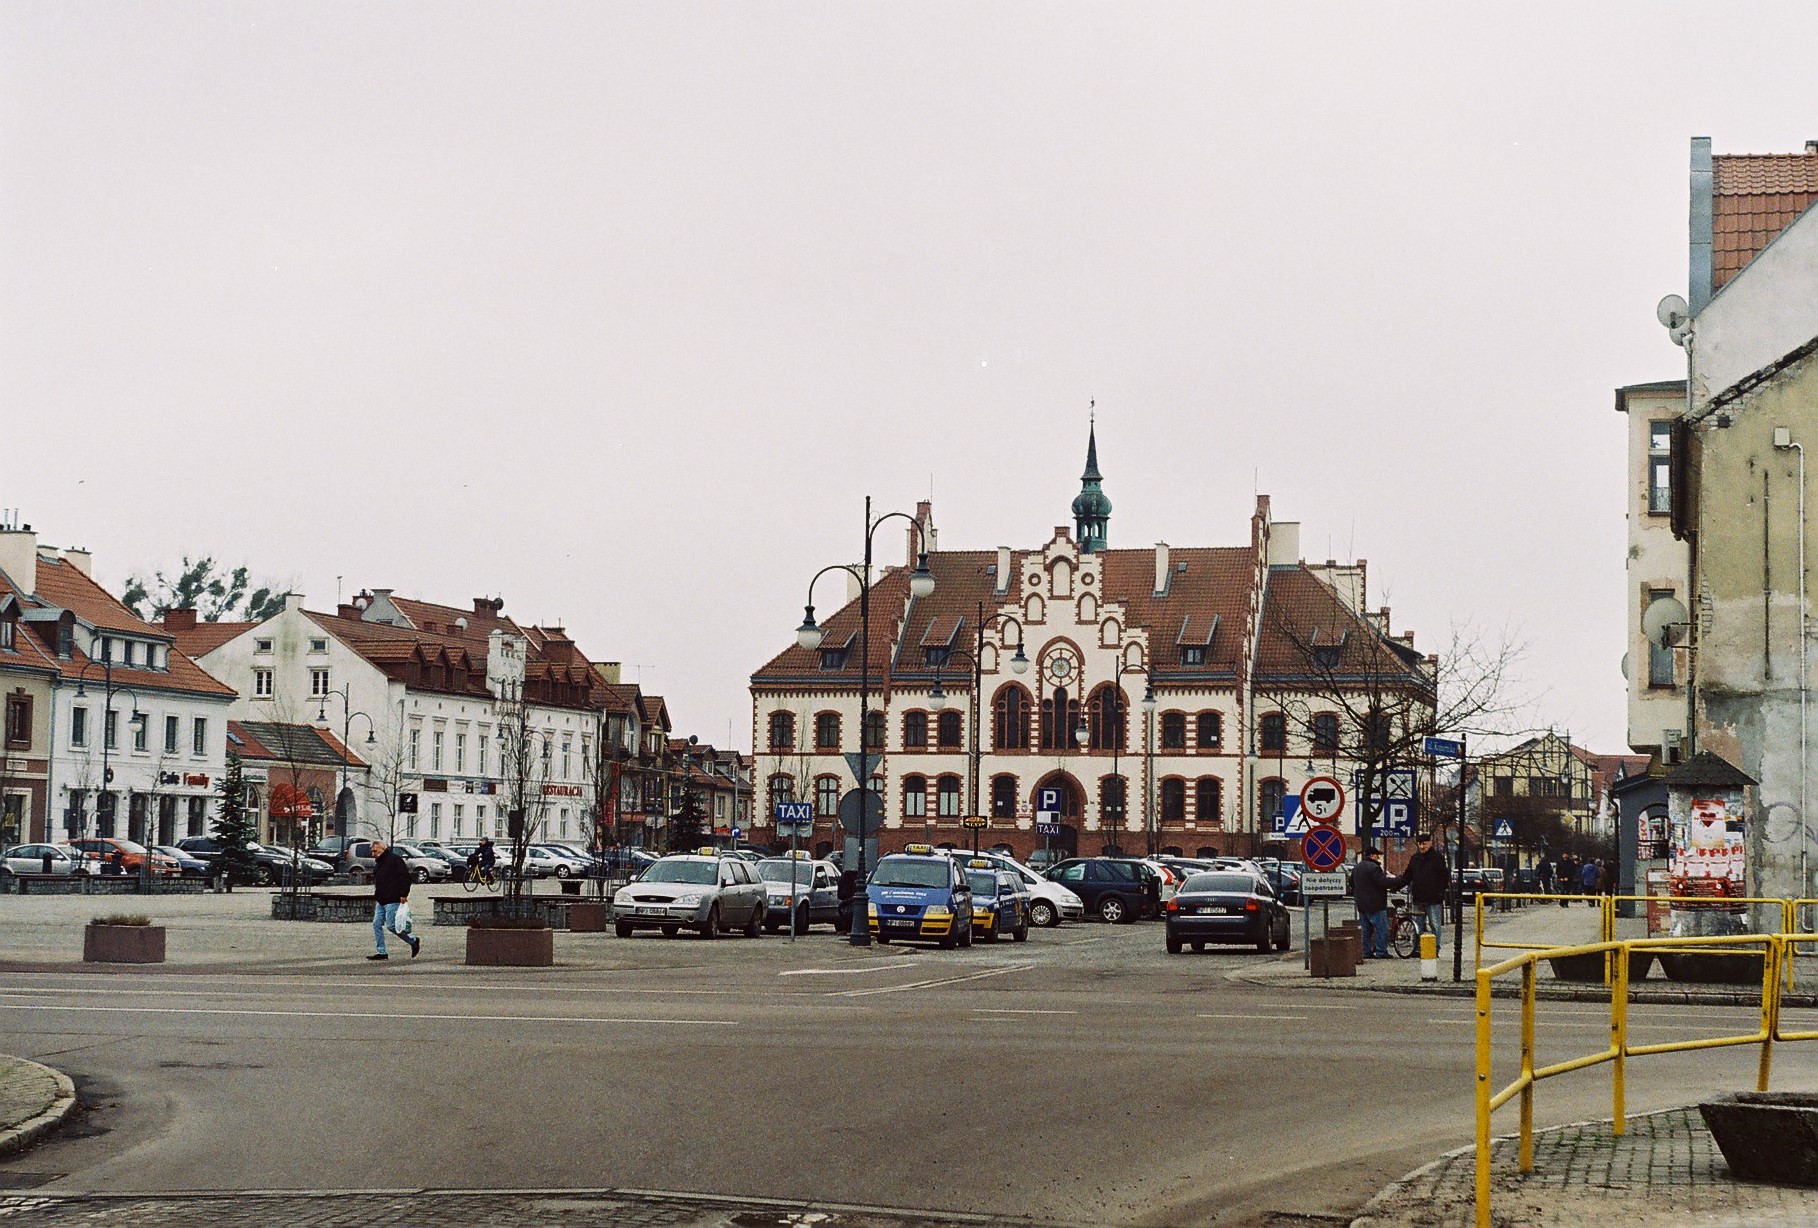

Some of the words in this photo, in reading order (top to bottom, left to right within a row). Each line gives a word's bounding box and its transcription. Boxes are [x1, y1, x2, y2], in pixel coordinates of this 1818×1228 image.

[160, 771, 180, 785] Cafe
[183, 772, 210, 789] Family
[1043, 790, 1057, 809] P
[779, 804, 810, 819] TAXI
[1390, 804, 1408, 828] P
[1038, 824, 1059, 834] TAXI
[1275, 816, 1285, 831] P
